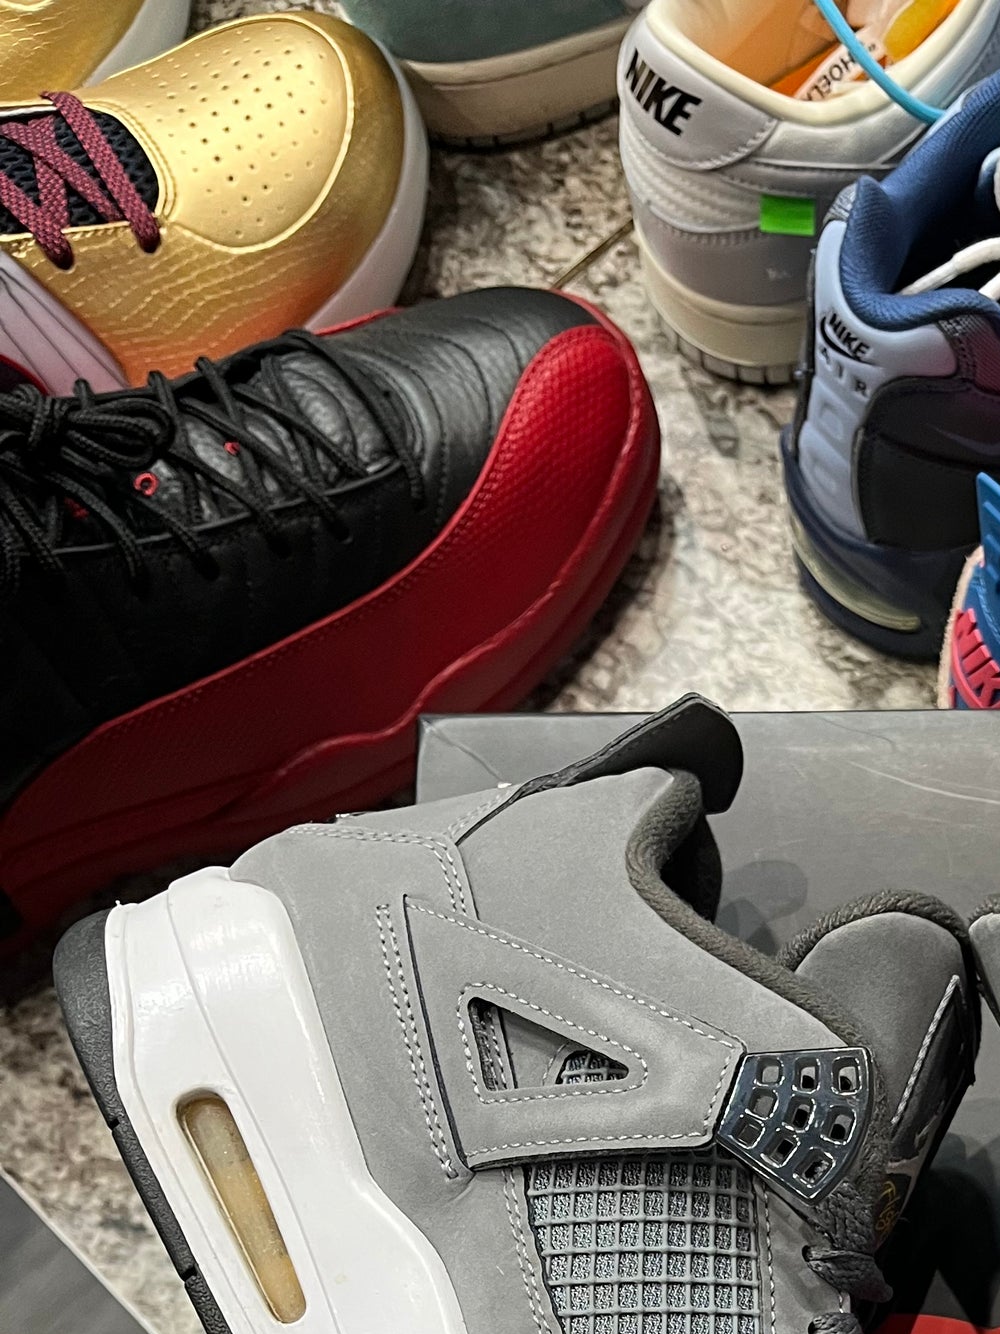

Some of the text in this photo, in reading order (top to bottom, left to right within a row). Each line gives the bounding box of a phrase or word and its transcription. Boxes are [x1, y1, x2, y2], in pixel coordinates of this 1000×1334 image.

[626, 47, 703, 135] NIKE
[828, 313, 870, 360] NIKE
[820, 347, 868, 398] AIR
